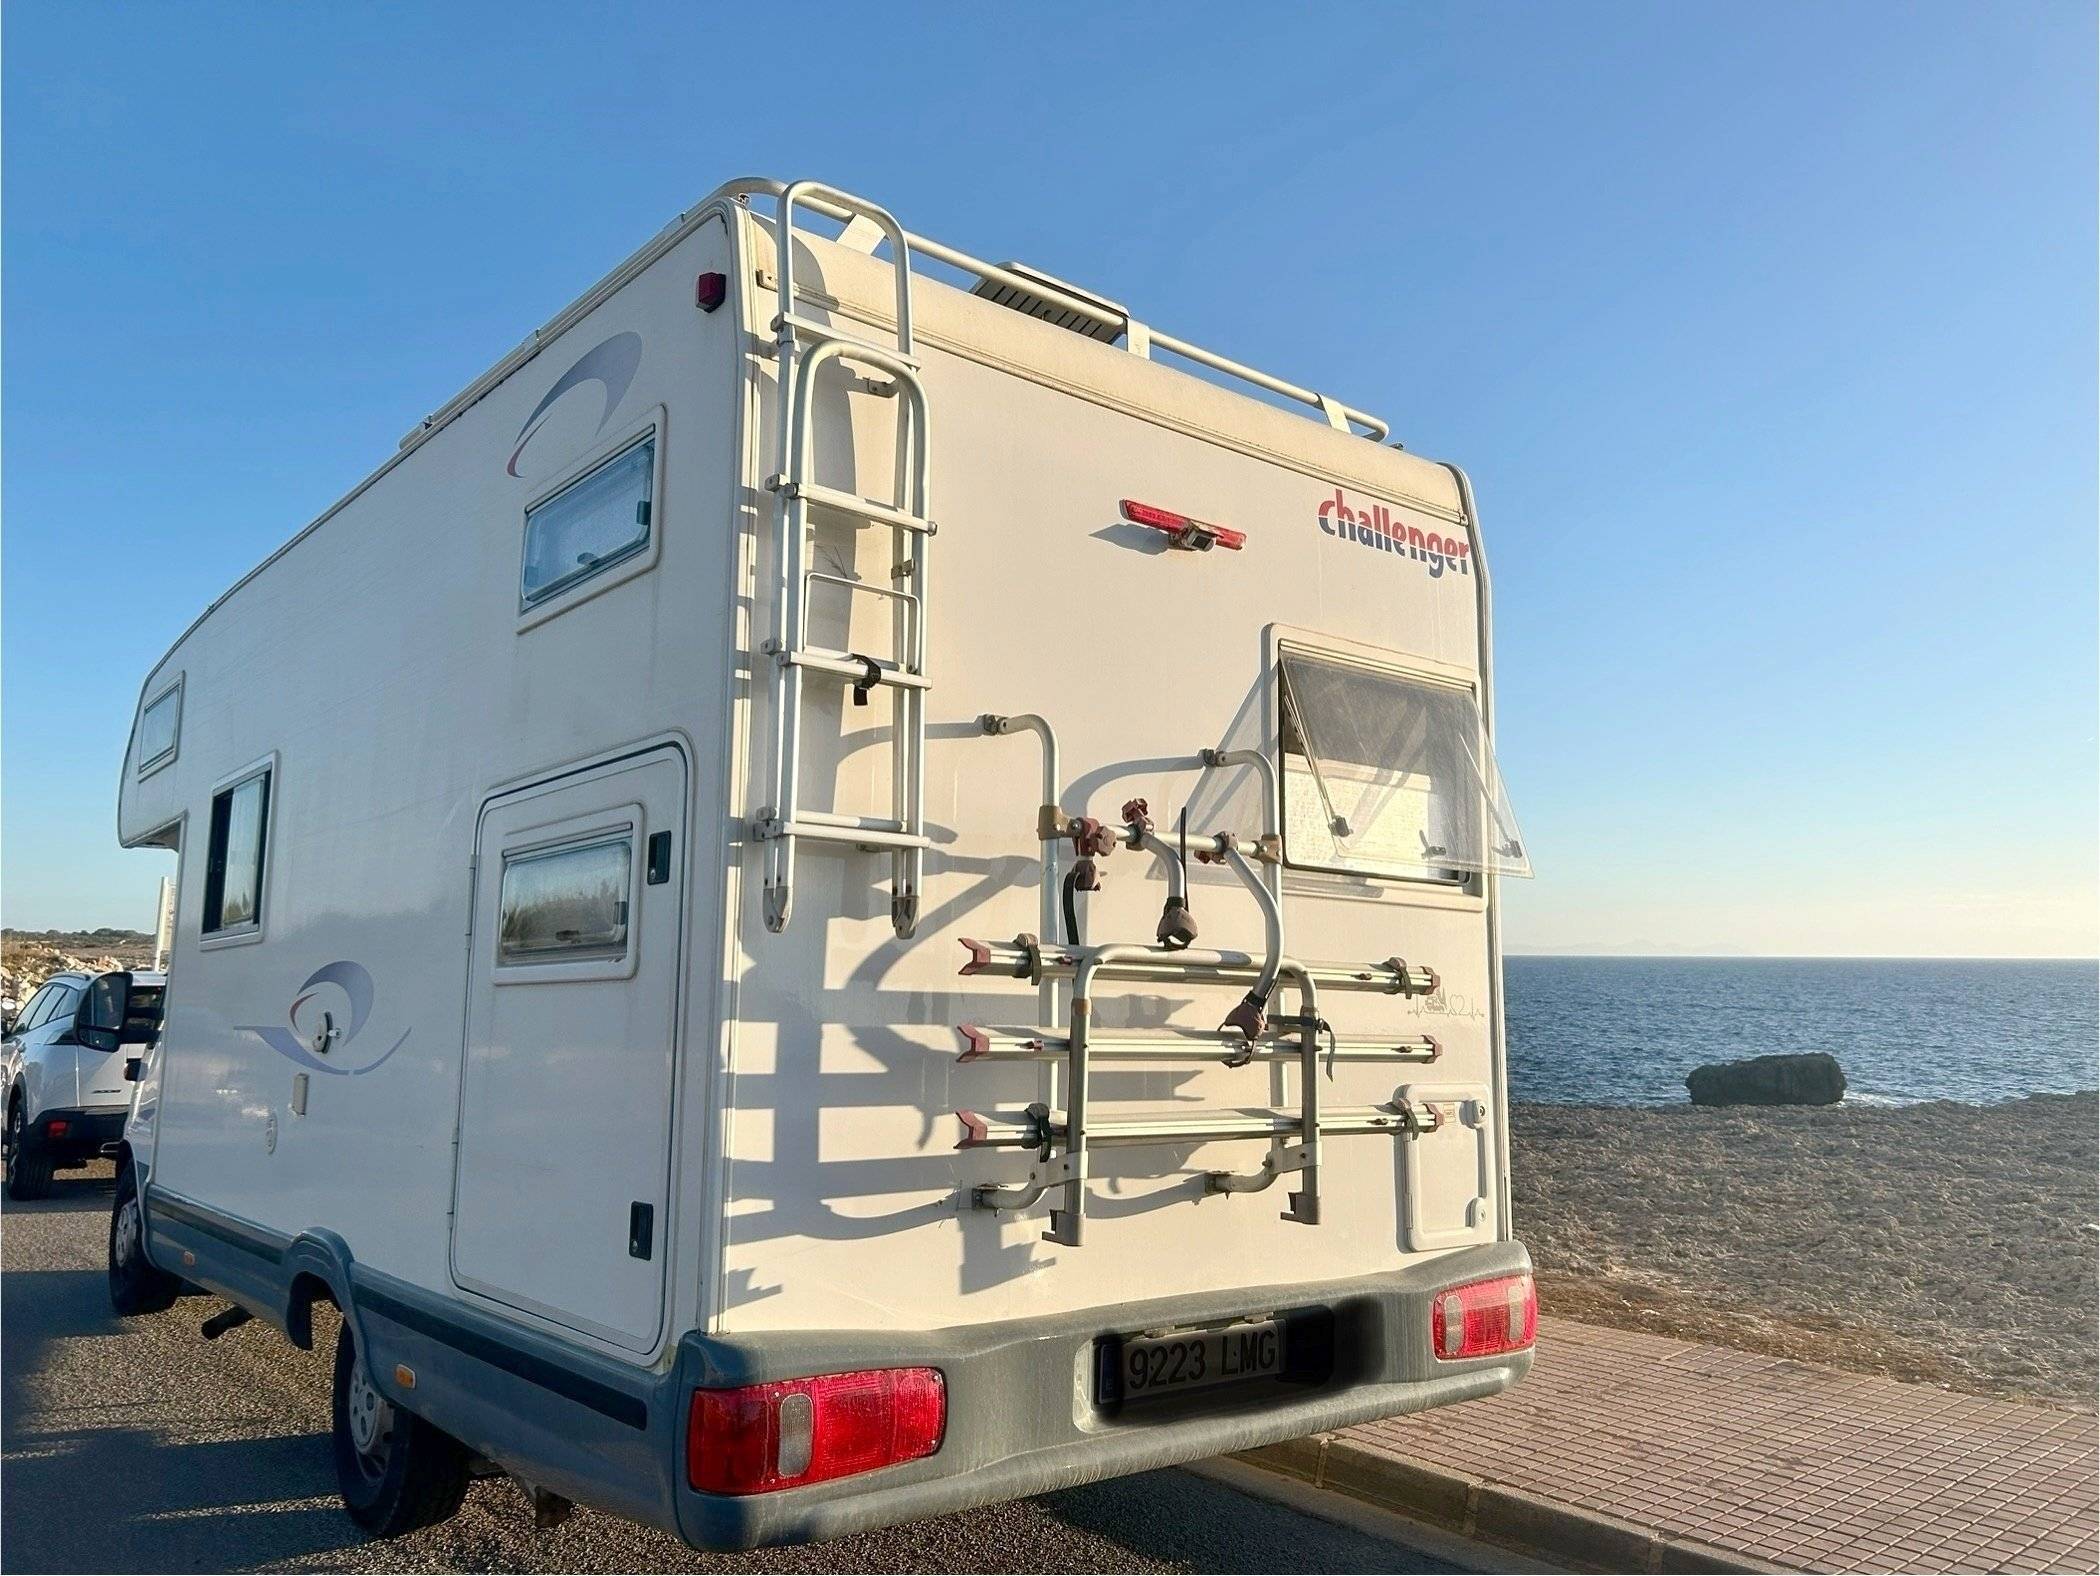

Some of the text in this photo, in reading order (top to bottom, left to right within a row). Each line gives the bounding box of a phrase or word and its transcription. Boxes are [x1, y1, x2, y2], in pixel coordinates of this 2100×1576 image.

[1317, 489, 1470, 579] challenger
[1129, 1330, 1277, 1390] 9223 LMG
